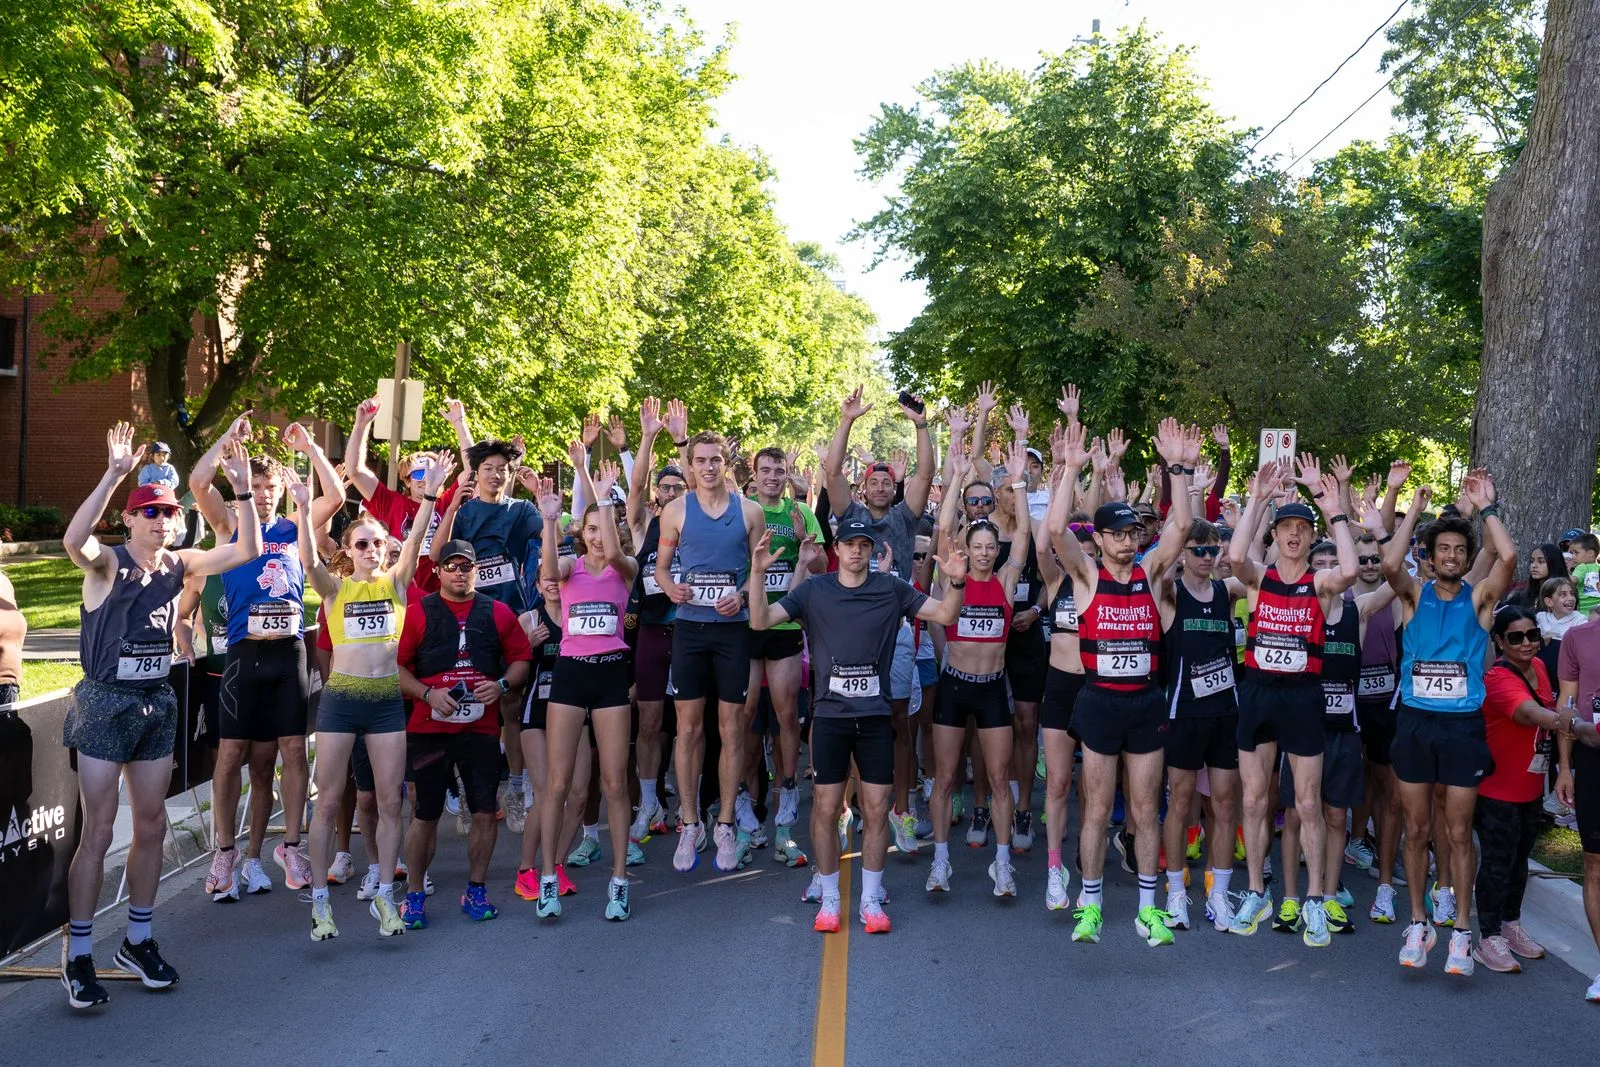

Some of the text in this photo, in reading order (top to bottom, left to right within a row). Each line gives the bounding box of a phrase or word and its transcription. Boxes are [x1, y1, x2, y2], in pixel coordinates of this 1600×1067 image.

[479, 566, 502, 581] 884
[698, 587, 724, 600] 707
[262, 616, 289, 630] 635
[358, 615, 385, 631] 939
[579, 616, 606, 630] 706
[970, 619, 993, 631] 949
[1097, 622, 1153, 631] ATHLETIC CLUB
[1257, 620, 1312, 633] ATHLETIC CLUB
[600, 652, 623, 663] PRO
[1112, 655, 1138, 669] 275
[1265, 649, 1292, 665] 626
[135, 657, 162, 673] 784
[946, 665, 997, 683] UNDER
[1204, 670, 1228, 688] 596
[842, 678, 868, 692] 498
[1363, 676, 1386, 690] 338
[1425, 677, 1453, 692] 745
